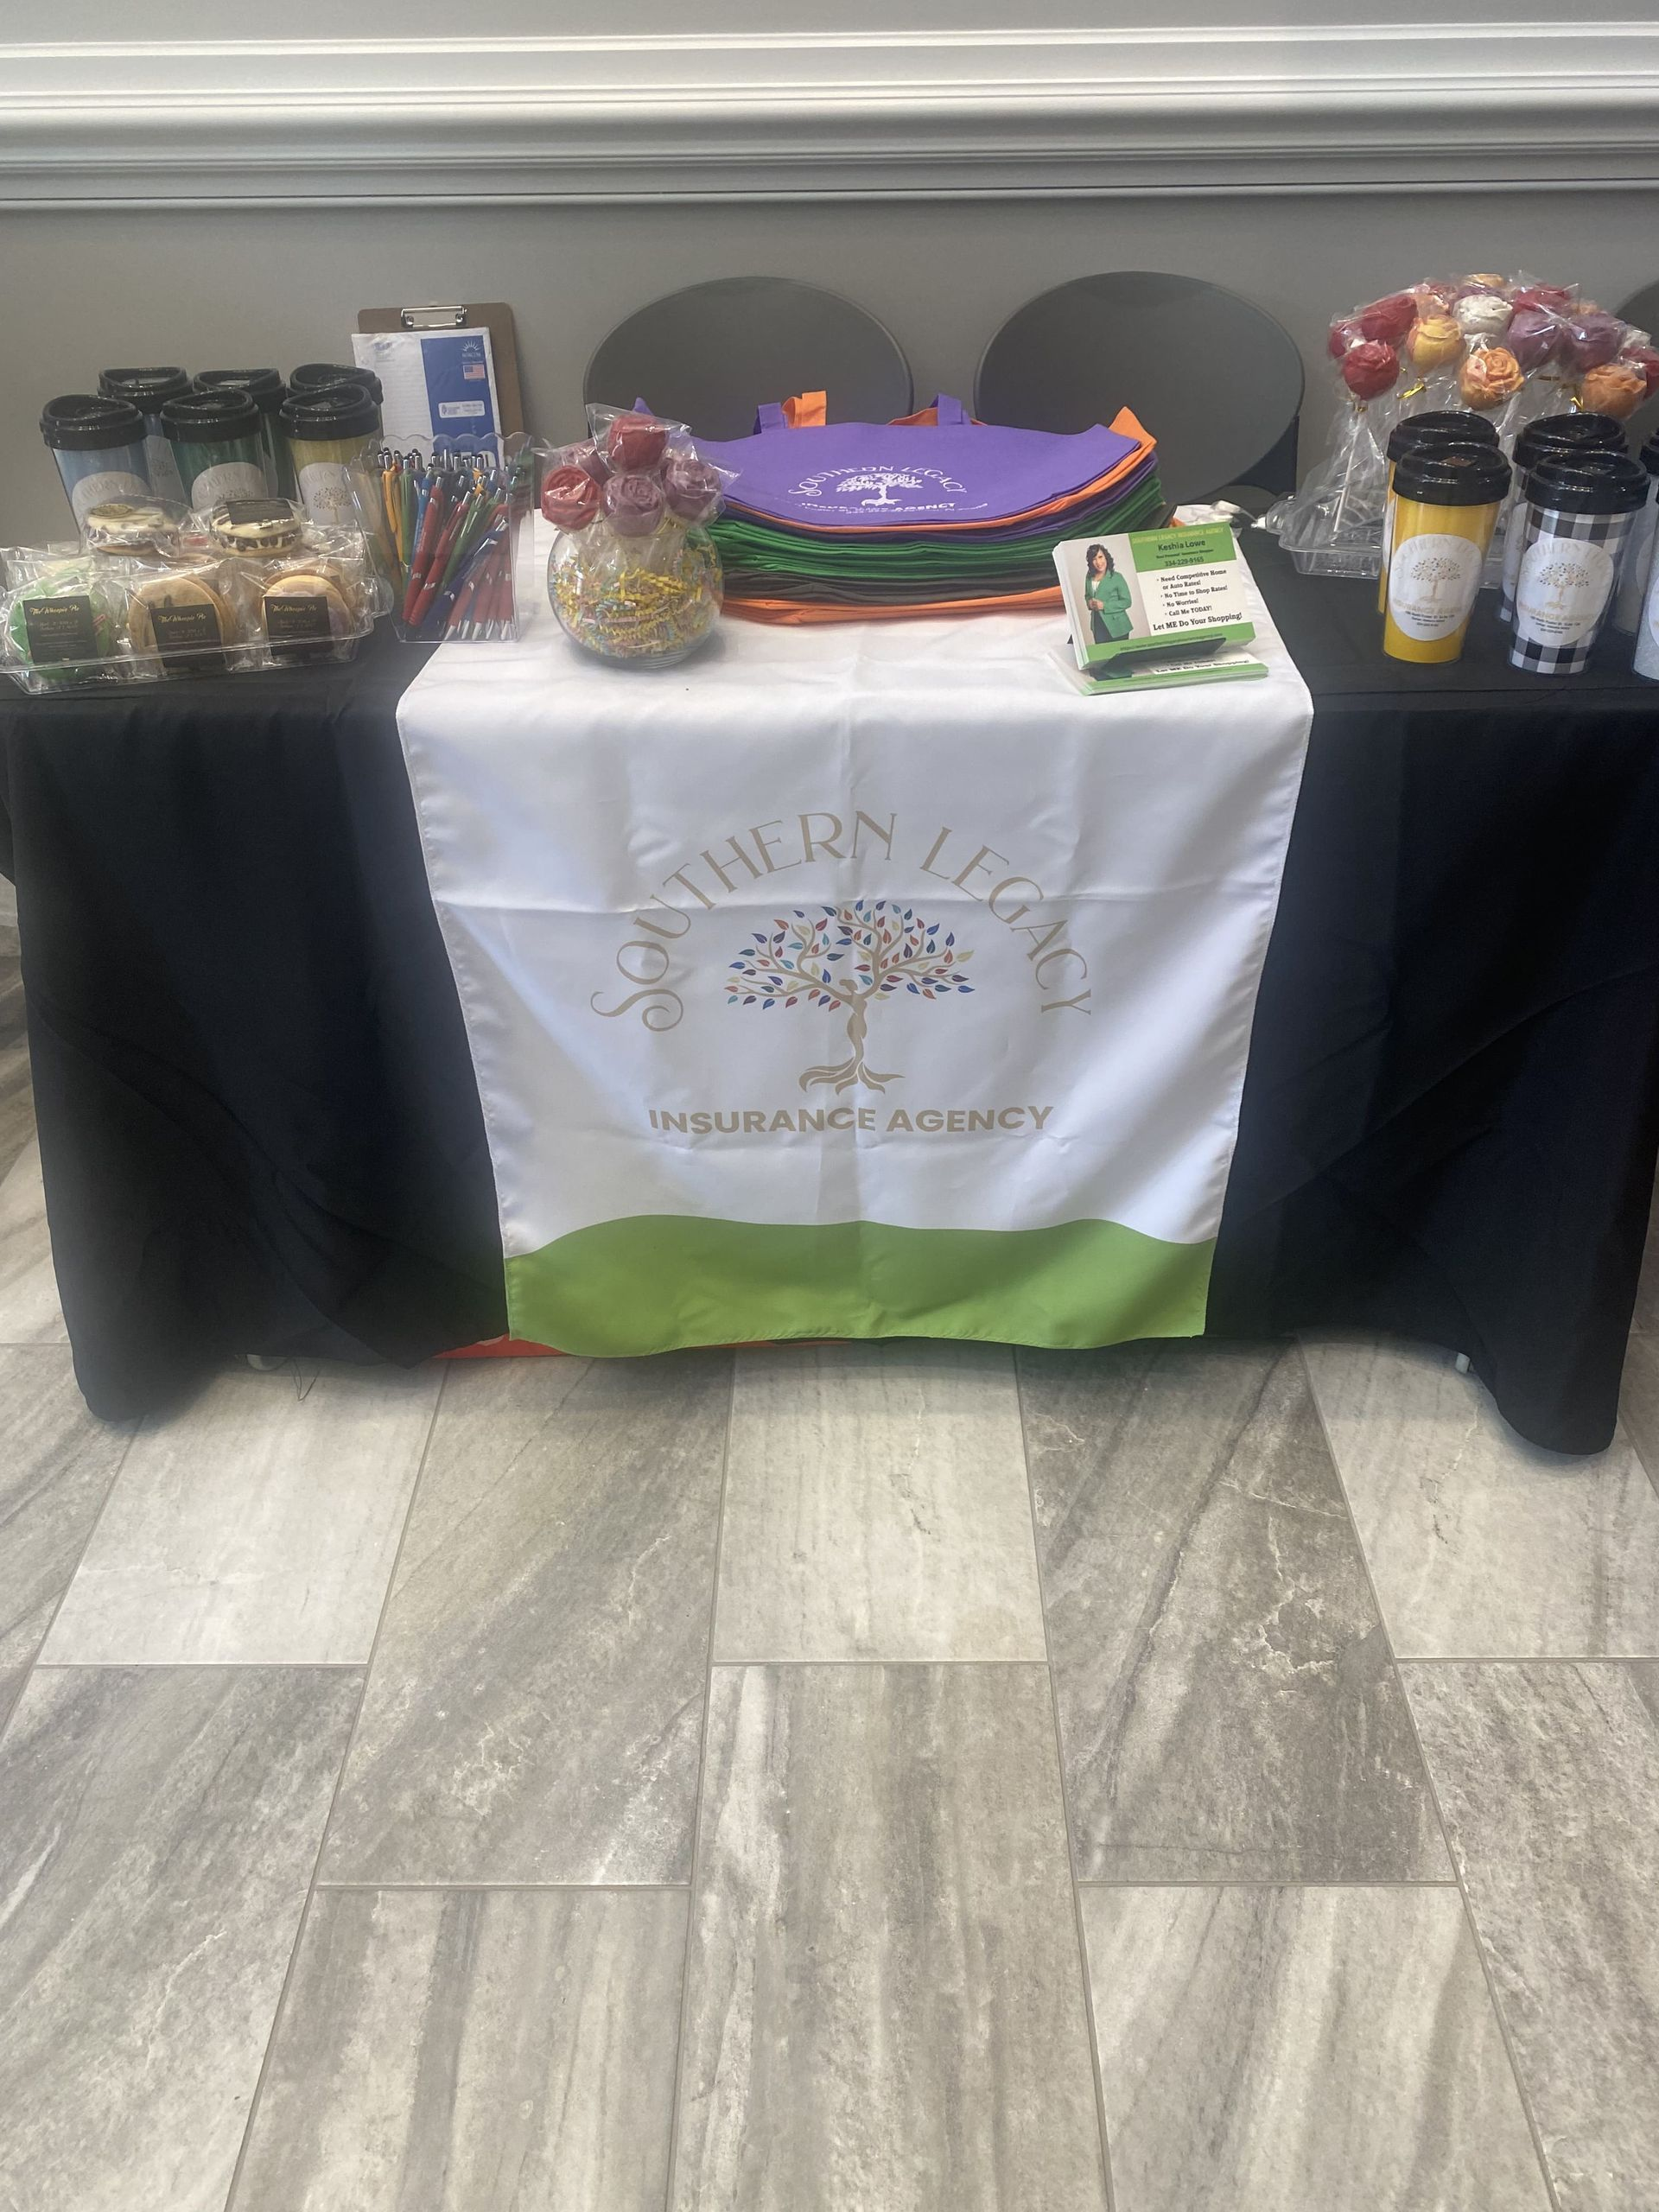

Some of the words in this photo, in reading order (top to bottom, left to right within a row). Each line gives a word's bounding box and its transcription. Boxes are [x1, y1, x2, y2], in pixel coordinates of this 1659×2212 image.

[1158, 543, 1184, 551] Keshia
[1176, 571, 1210, 581] Competitive
[1196, 588, 1211, 596] Shop
[1175, 598, 1199, 607] Worries!
[1190, 617, 1206, 626] Your
[1208, 612, 1243, 623] Shopping!
[590, 810, 898, 1033] SOUTHERN
[919, 826, 1092, 1016] LEGACY
[649, 1107, 876, 1135] INSURANCE
[887, 1106, 1054, 1133] AGENCY
